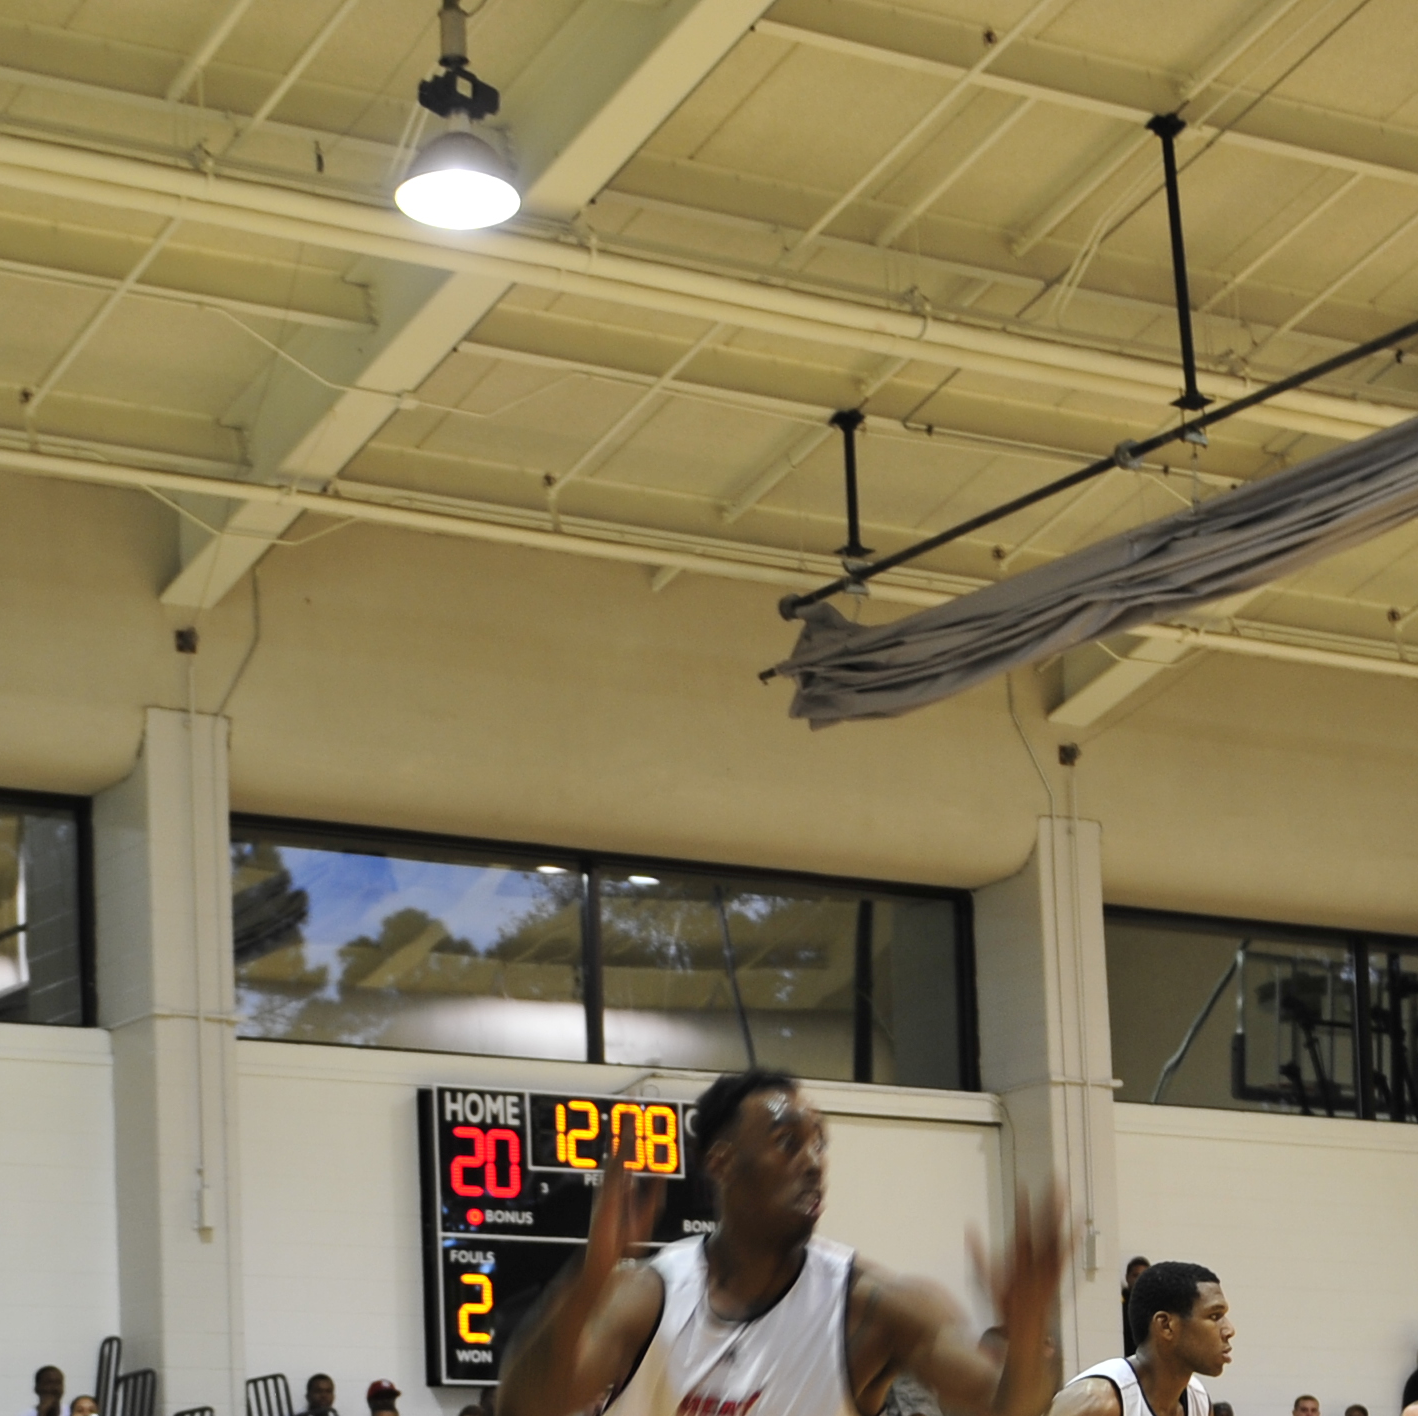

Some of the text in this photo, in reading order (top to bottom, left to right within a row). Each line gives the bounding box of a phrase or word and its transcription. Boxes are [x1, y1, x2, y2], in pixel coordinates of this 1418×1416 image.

[444, 1091, 521, 1126] HOME
[450, 1126, 522, 1199] 20
[485, 1209, 534, 1225] BONUS
[450, 1249, 495, 1265] FOULS
[458, 1273, 493, 1344] 2
[456, 1349, 493, 1363] WON
